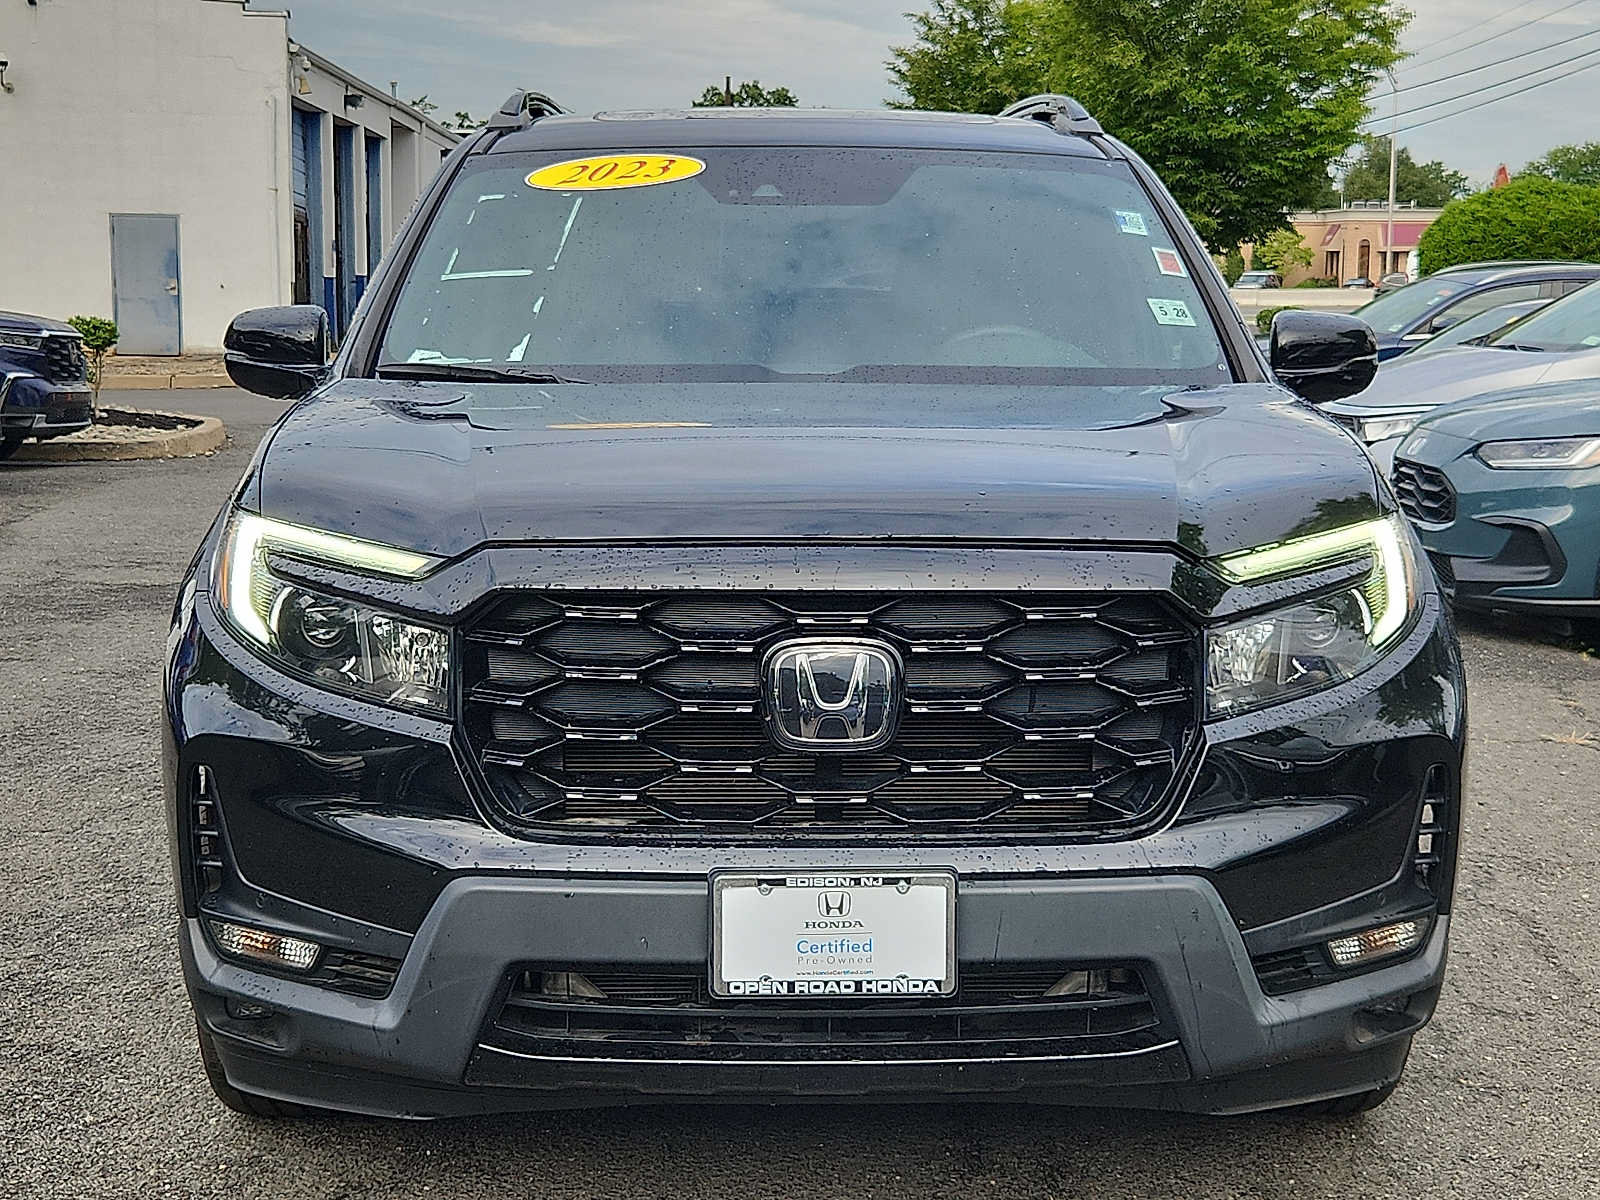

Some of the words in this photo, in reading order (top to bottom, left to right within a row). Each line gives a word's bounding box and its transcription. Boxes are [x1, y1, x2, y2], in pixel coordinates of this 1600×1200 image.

[555, 159, 676, 185] 2023
[1159, 306, 1168, 316] 5
[1173, 307, 1188, 319] 28
[786, 877, 855, 887] EDISON,
[861, 877, 883, 887] NJ
[803, 920, 865, 929] HONDA
[797, 938, 873, 954] Certified
[798, 954, 873, 965] Pre-Owned
[728, 980, 789, 994] OPEN
[795, 980, 856, 994] ROAD
[862, 979, 940, 993] HONDA
